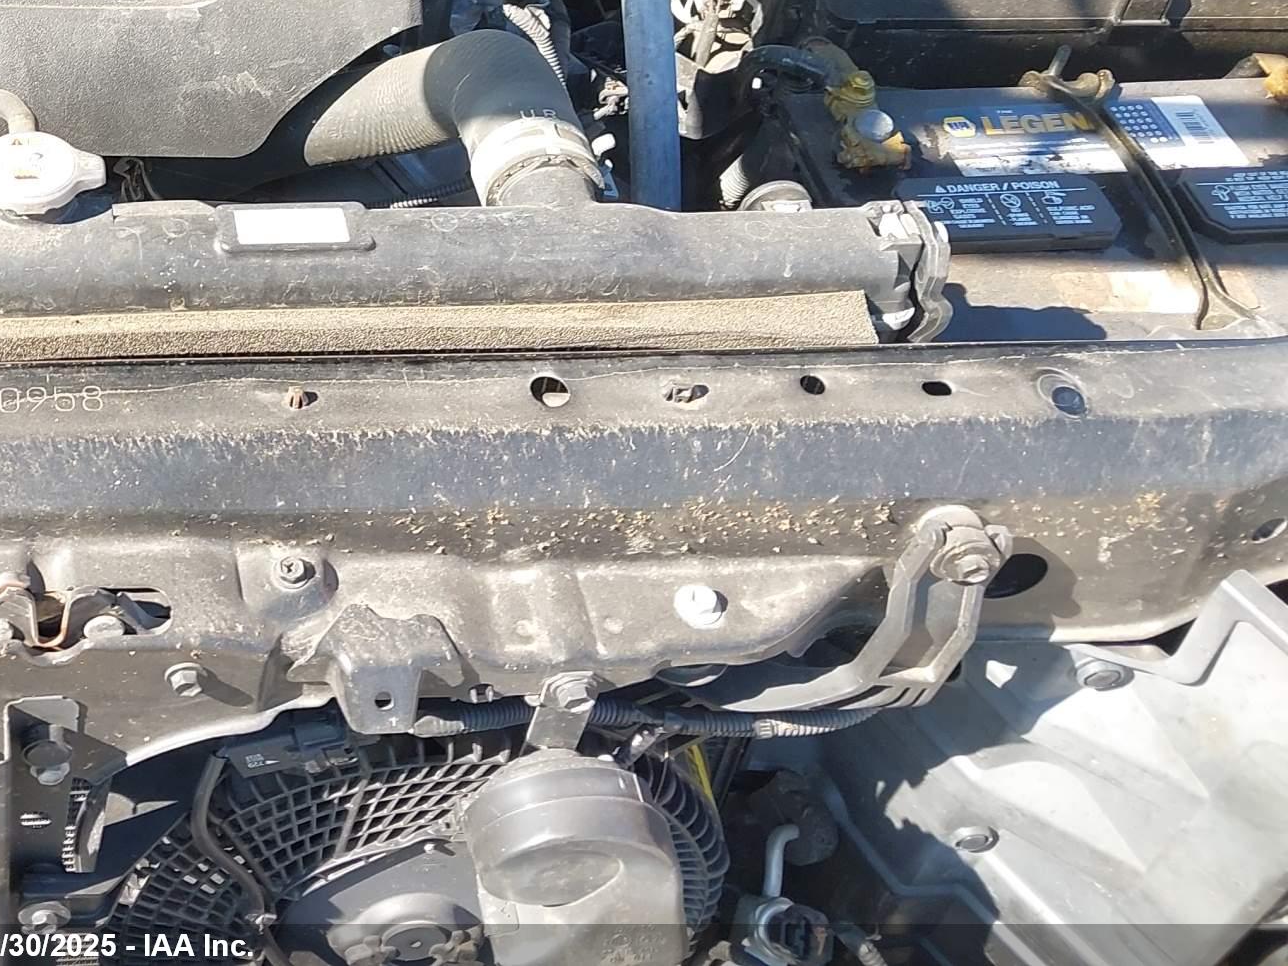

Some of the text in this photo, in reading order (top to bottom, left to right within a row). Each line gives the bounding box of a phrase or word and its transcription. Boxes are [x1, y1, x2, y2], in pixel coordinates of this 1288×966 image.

[980, 112, 1095, 135] LEGEN
[946, 182, 1001, 194] DANGER
[1010, 180, 1061, 191] POISON
